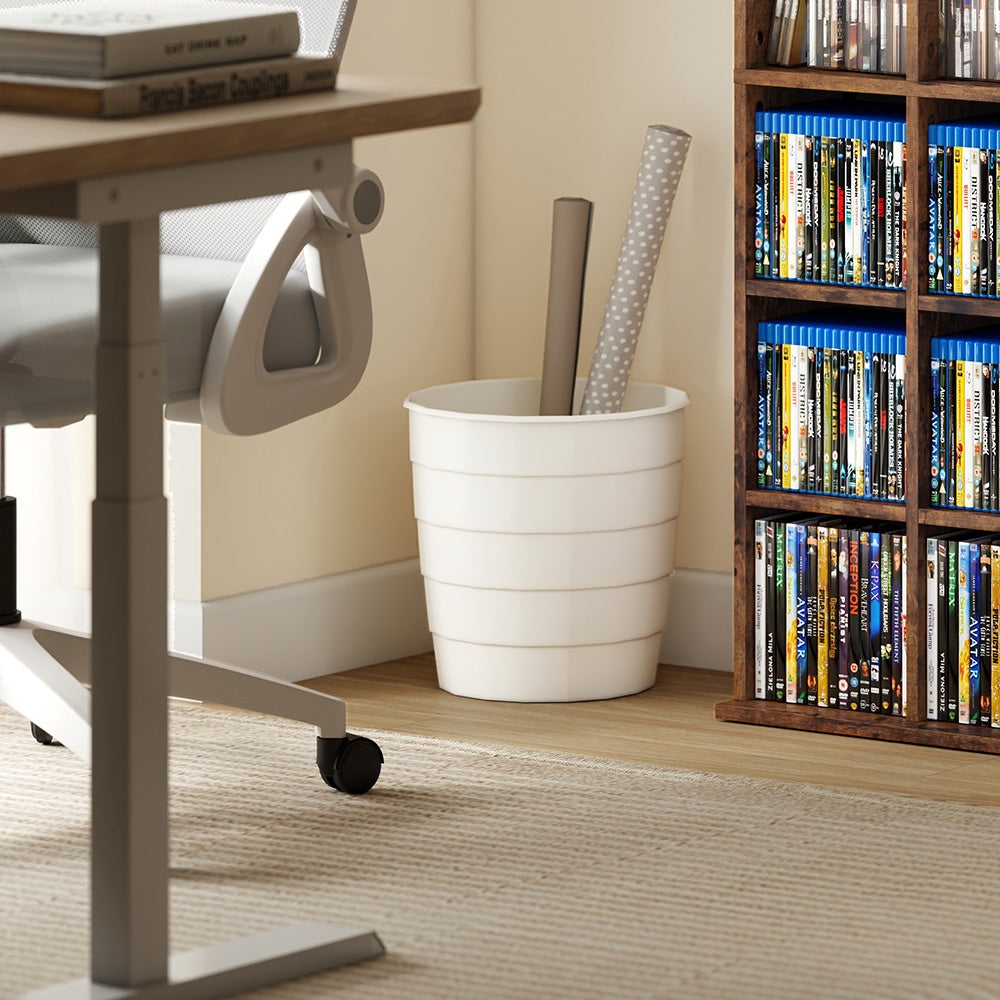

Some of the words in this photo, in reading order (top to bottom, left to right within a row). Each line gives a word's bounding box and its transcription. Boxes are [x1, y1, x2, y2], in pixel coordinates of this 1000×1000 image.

[187, 77, 227, 104] Bacon
[850, 541, 858, 615] INCEPTION
[861, 578, 869, 632] BRAVEHEART
[871, 560, 879, 601] K-PAX
[797, 597, 805, 659] AVATAR
[970, 617, 978, 679] AVATAR
